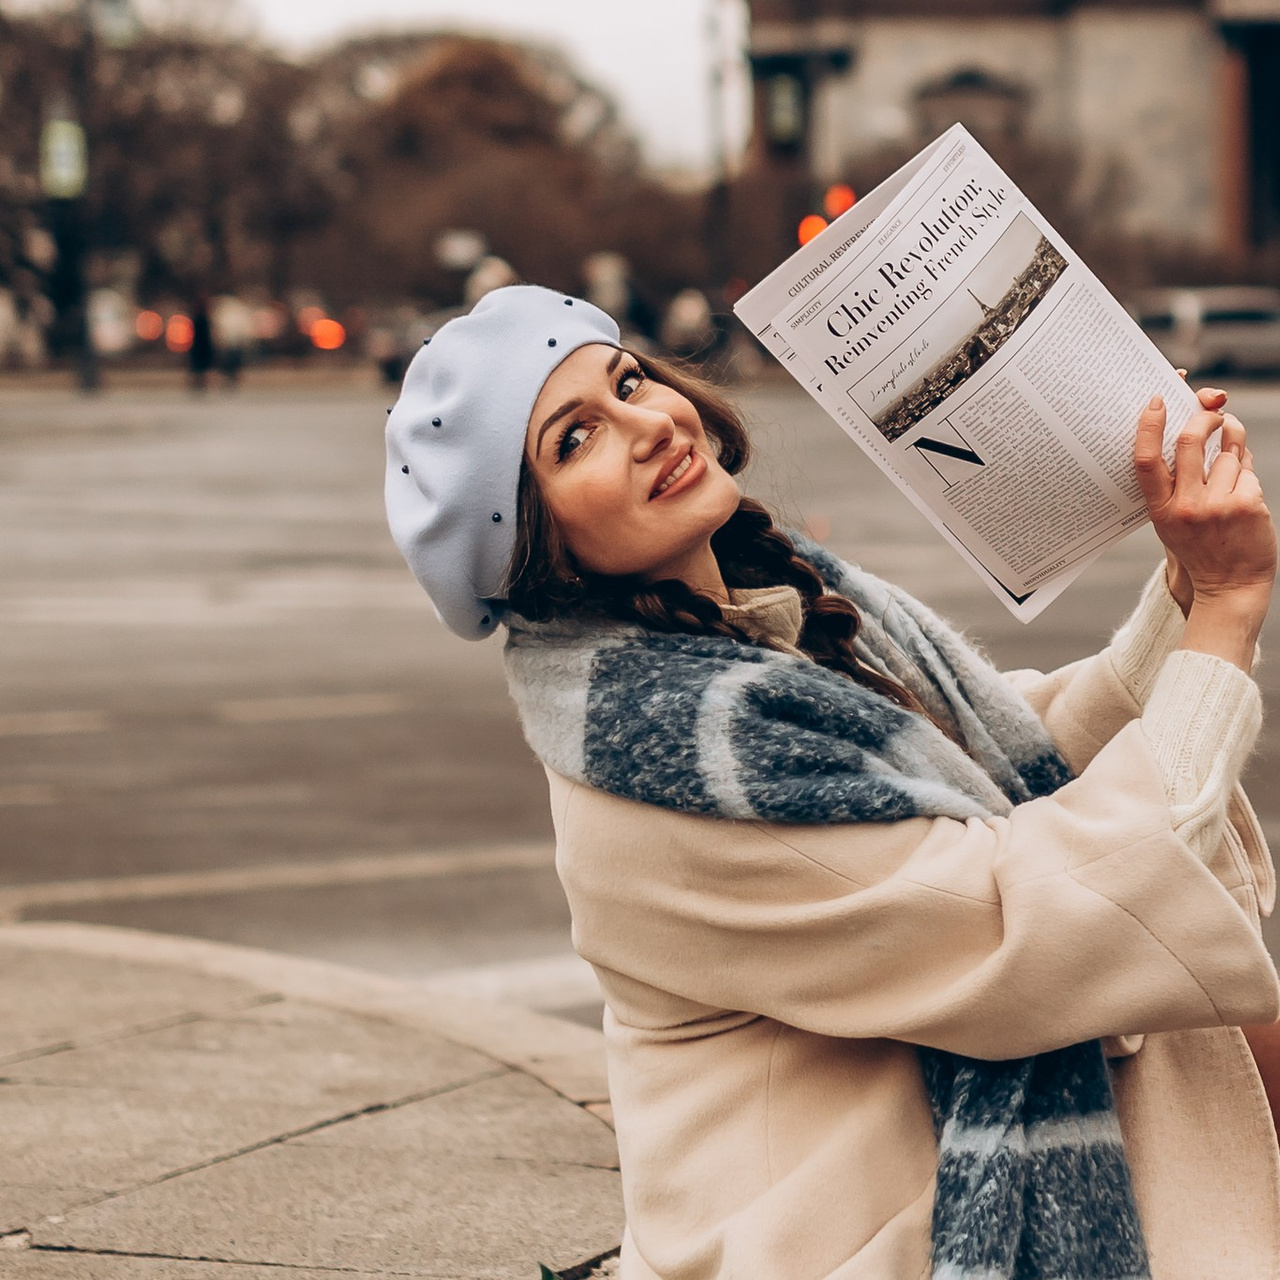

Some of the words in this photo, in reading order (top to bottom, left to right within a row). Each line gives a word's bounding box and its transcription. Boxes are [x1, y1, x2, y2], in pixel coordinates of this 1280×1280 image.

[788, 299, 824, 330] SIMPLICITY
[877, 217, 904, 247] ELEGANCE
[788, 260, 834, 301] CULTURAL
[823, 279, 934, 378] Reinventing
[923, 224, 978, 282] French
[971, 189, 1008, 229] Style
[826, 289, 884, 338] Chic
[878, 179, 983, 290] Revolution:
[1023, 559, 1067, 589] INDIVIDUALITY
[1121, 507, 1151, 528] ROMANTI
